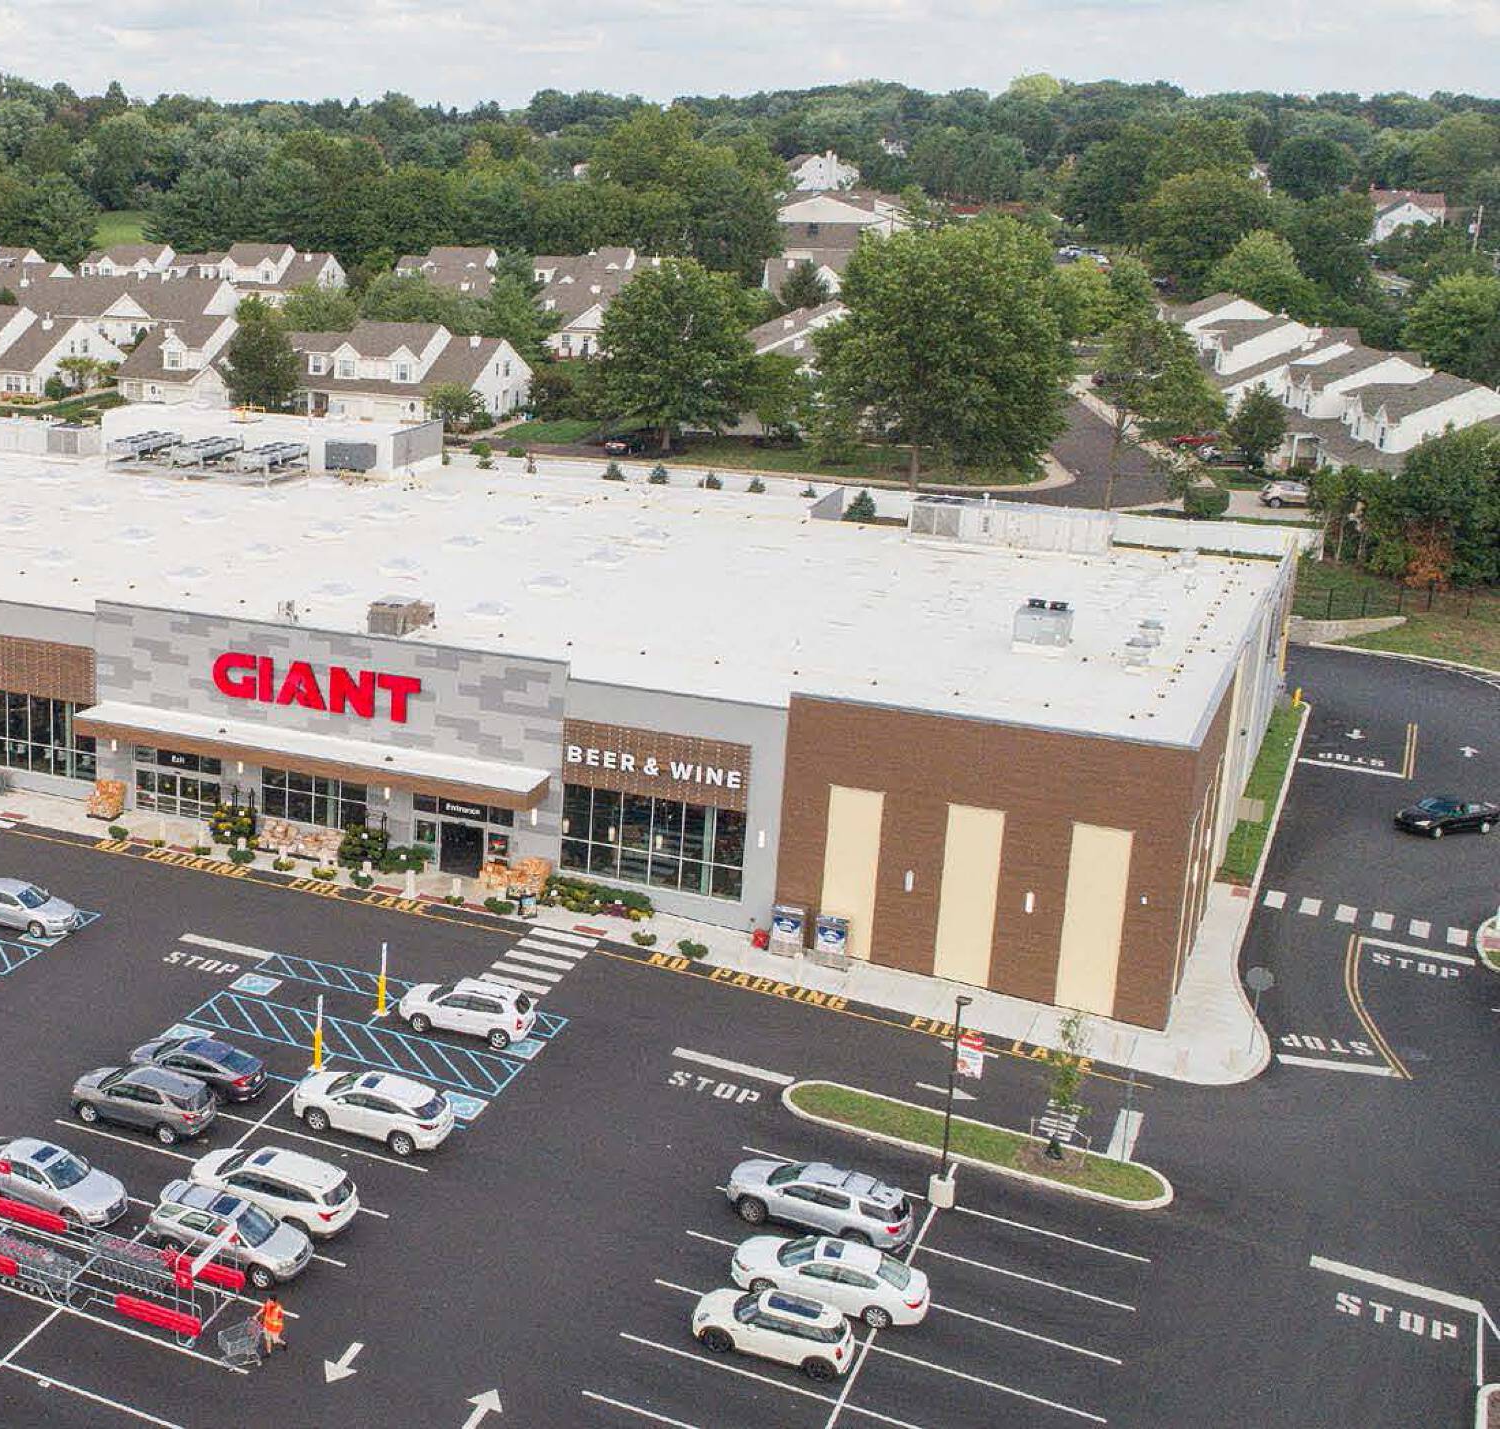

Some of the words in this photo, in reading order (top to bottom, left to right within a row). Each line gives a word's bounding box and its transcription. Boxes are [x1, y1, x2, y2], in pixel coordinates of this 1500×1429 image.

[213, 652, 422, 724] GIANT
[567, 745, 635, 773] BEER
[643, 757, 660, 776] &
[670, 761, 743, 789] WINE
[1317, 752, 1386, 768] STOP
[445, 802, 481, 815] Entrance
[163, 951, 240, 974] STOP
[1372, 952, 1460, 979] STOP
[649, 952, 691, 971] NO
[708, 967, 849, 1010] PARKING
[1280, 1033, 1375, 1056] STOP
[667, 1071, 761, 1103] STOP
[1336, 1292, 1457, 1341] STOP
